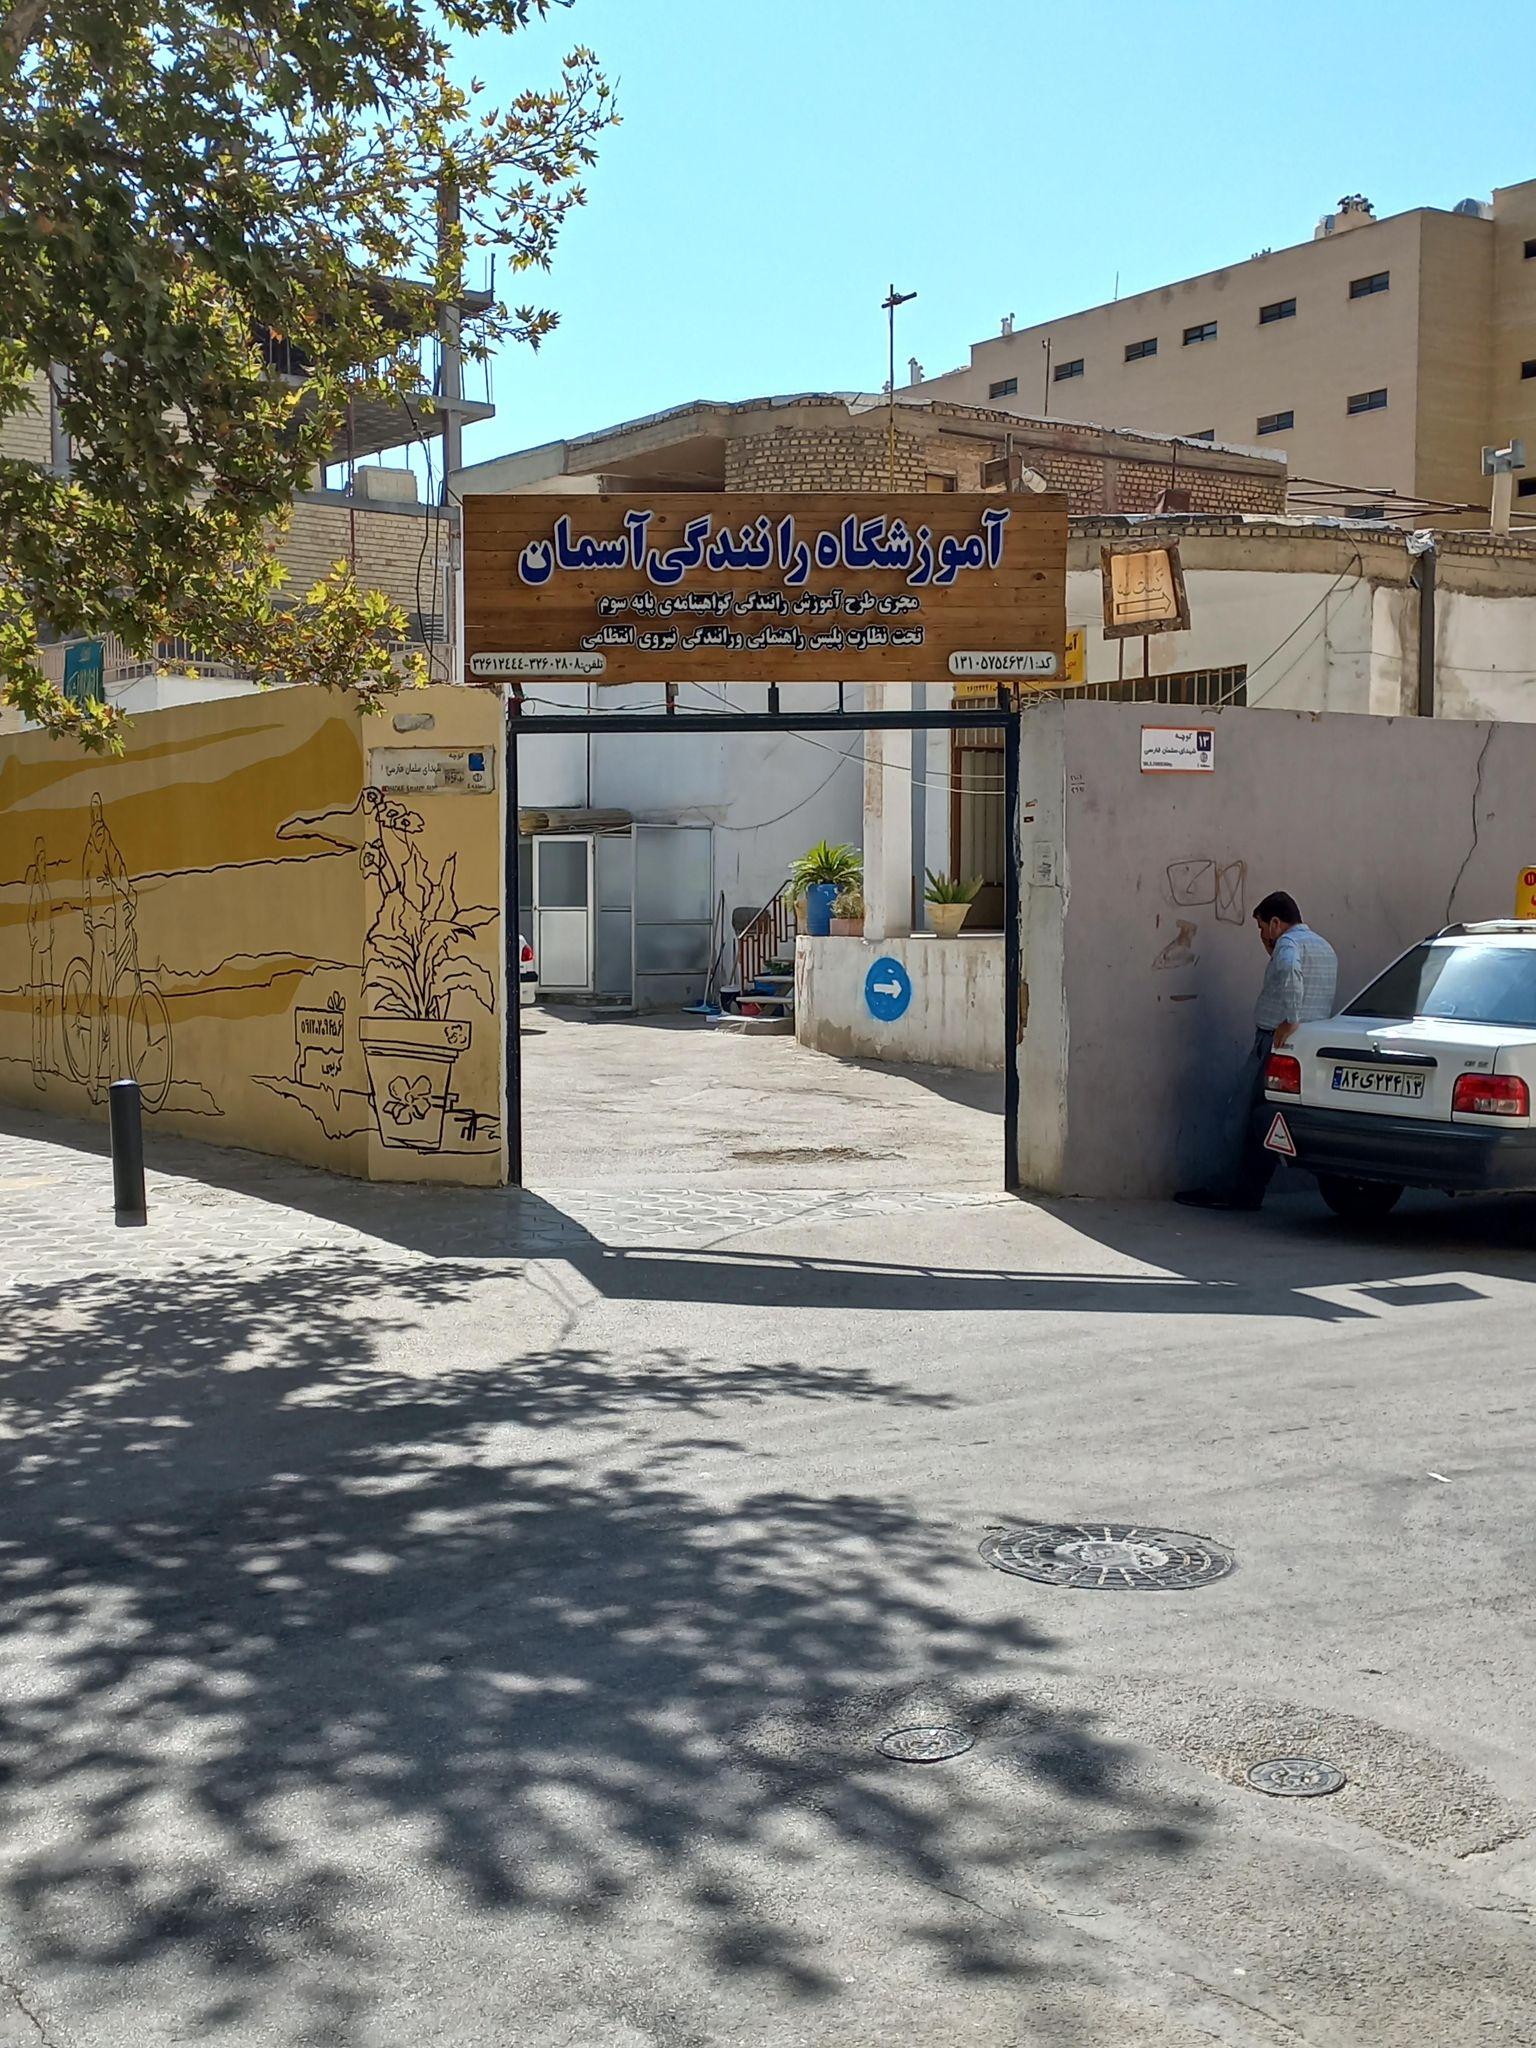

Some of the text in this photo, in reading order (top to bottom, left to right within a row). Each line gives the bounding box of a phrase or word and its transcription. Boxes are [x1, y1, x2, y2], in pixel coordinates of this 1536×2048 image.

[518, 508, 1010, 586] آموزشگاه رانندگی آسمان
[598, 596, 628, 616] سوم
[630, 590, 657, 616] پایه
[734, 591, 789, 616] رانندگی
[793, 589, 843, 616] آموزش
[844, 590, 876, 616] طرح
[878, 595, 920, 615] مجری
[581, 623, 636, 650] انتظامی
[637, 624, 679, 650] نیروی
[746, 624, 805, 650] راهنمایی
[809, 625, 845, 650] پلیس
[846, 625, 889, 650] نظارت
[891, 626, 925, 646] تحت
[1175, 733, 1193, 742] کوچه
[1199, 735, 1210, 747] ۱۳
